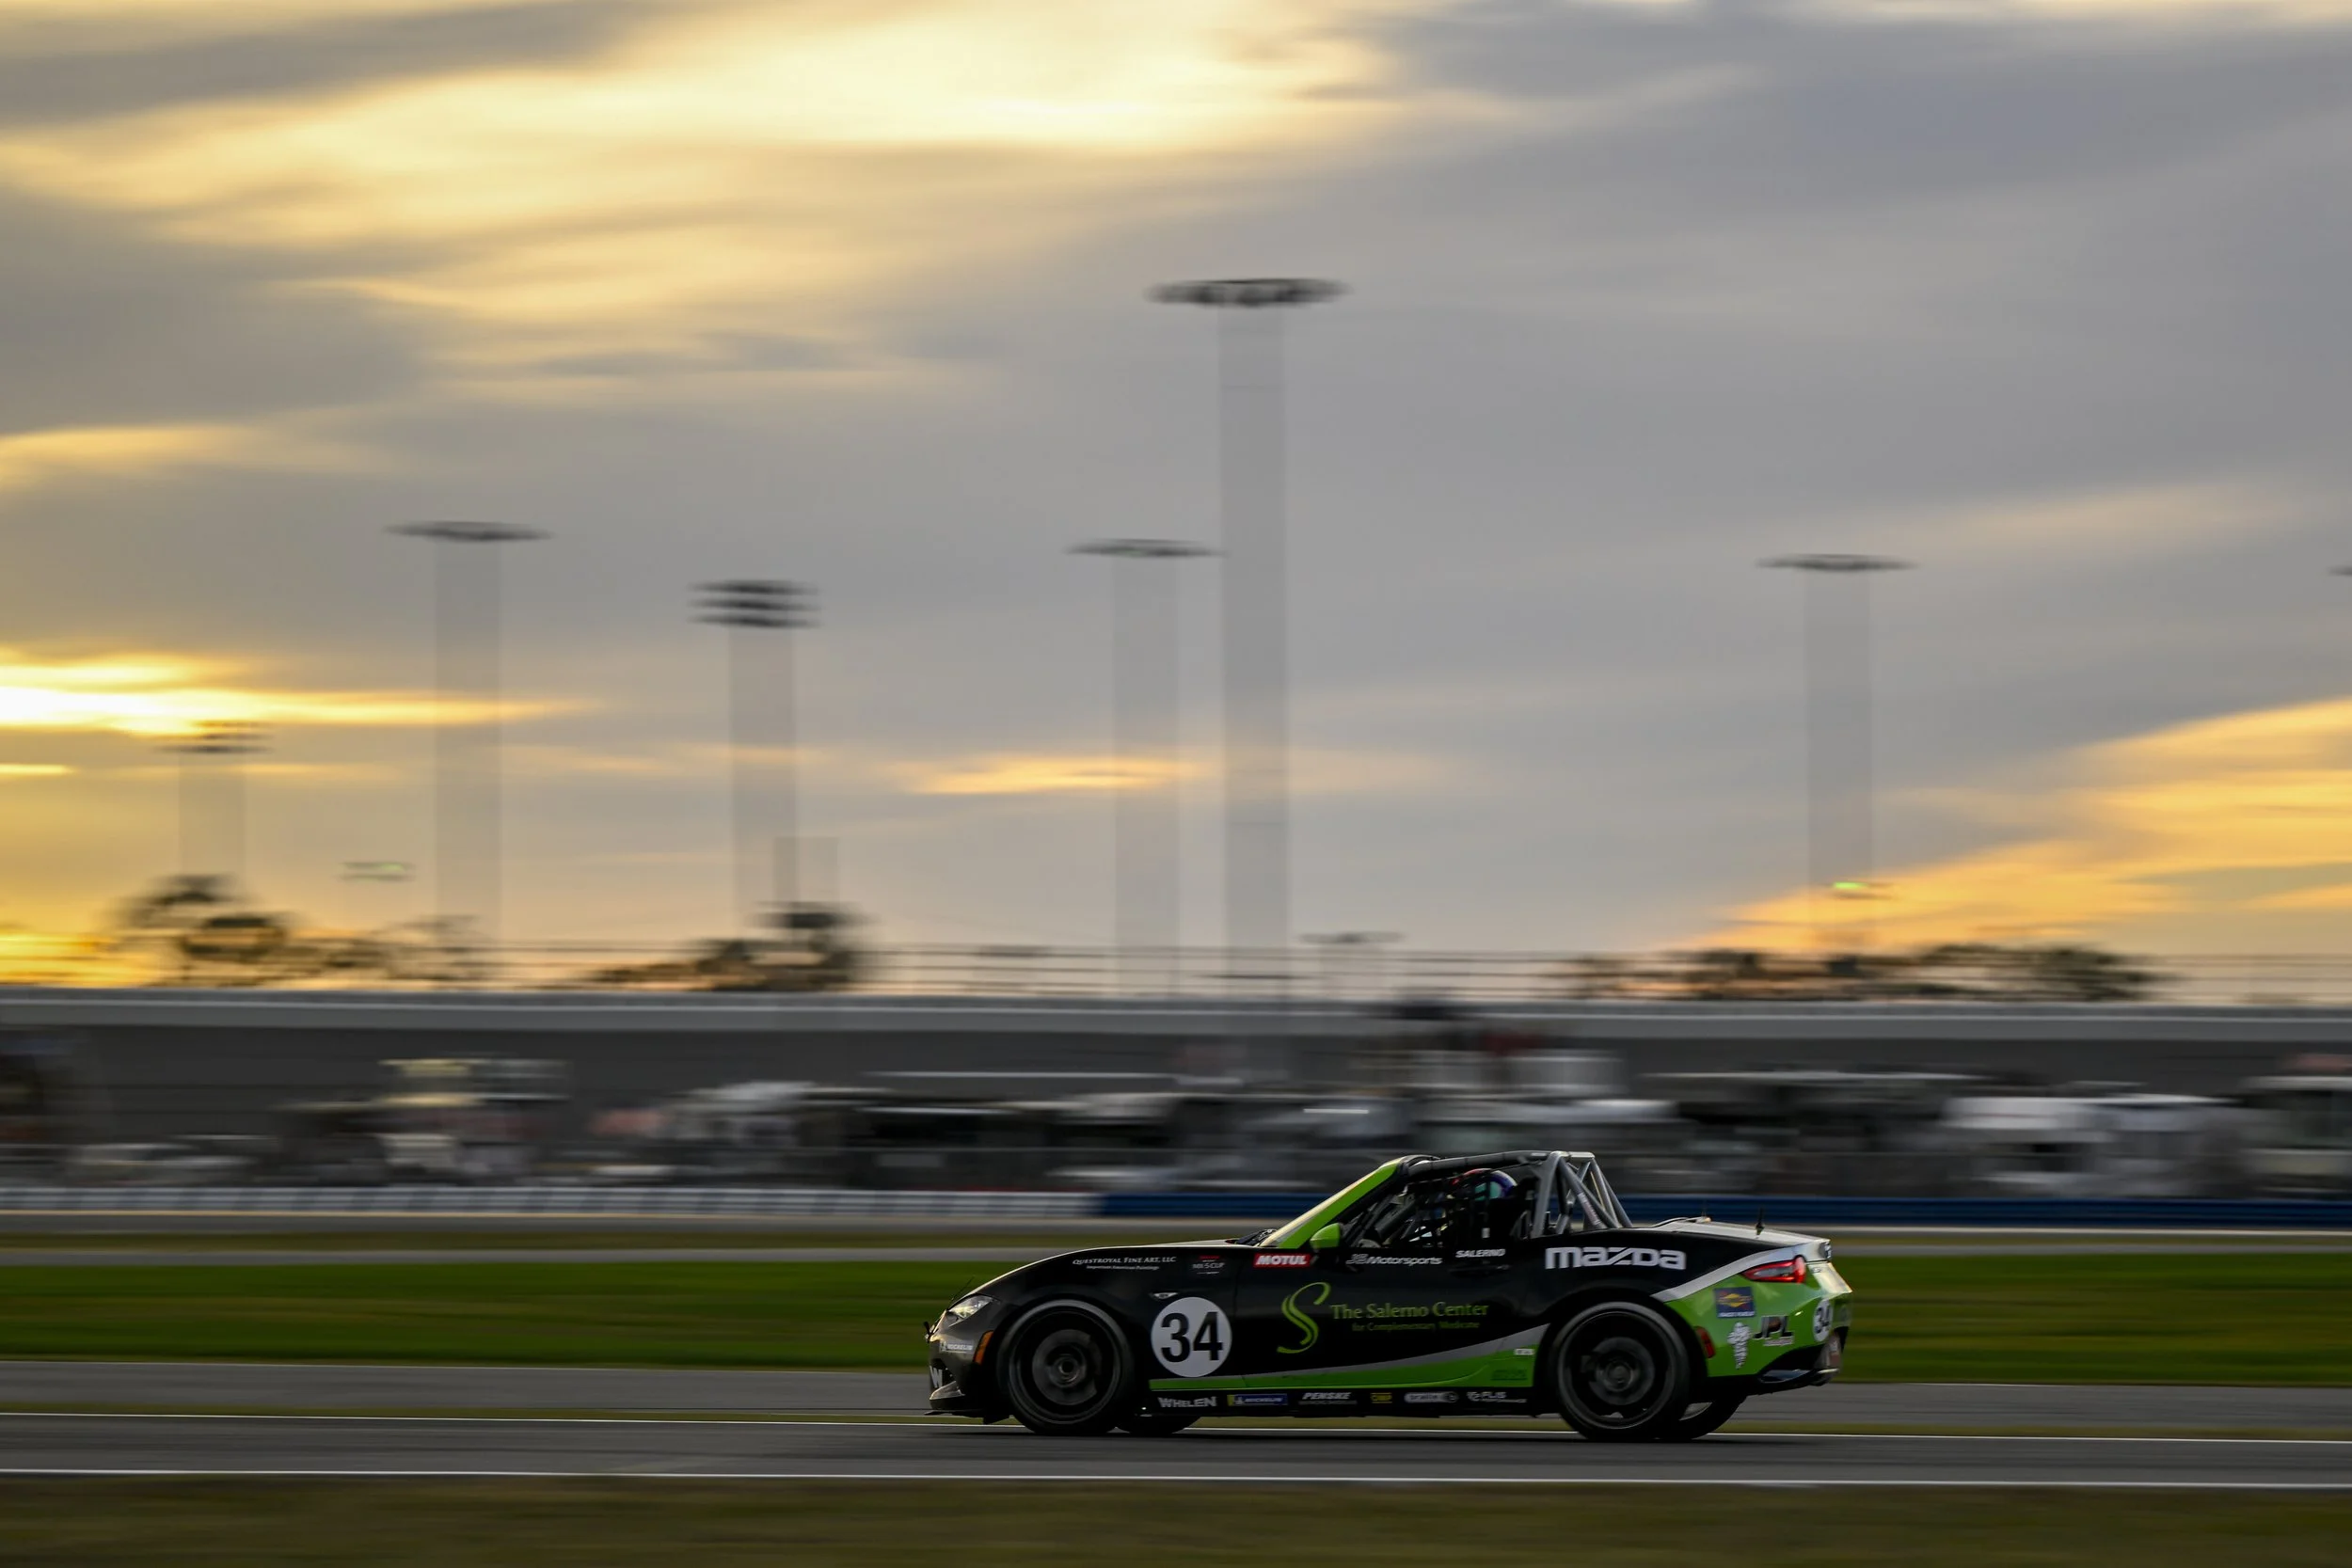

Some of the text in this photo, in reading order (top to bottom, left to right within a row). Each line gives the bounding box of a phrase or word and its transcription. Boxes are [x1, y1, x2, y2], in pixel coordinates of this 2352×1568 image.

[1455, 1248, 1506, 1259] SALERNO
[1255, 1255, 1308, 1265] MOTUL
[1331, 1301, 1489, 1320] The Salerno Center
[1352, 1322, 1366, 1331] for
[1161, 1311, 1223, 1362] 34
[1302, 1391, 1352, 1400] PENSKE
